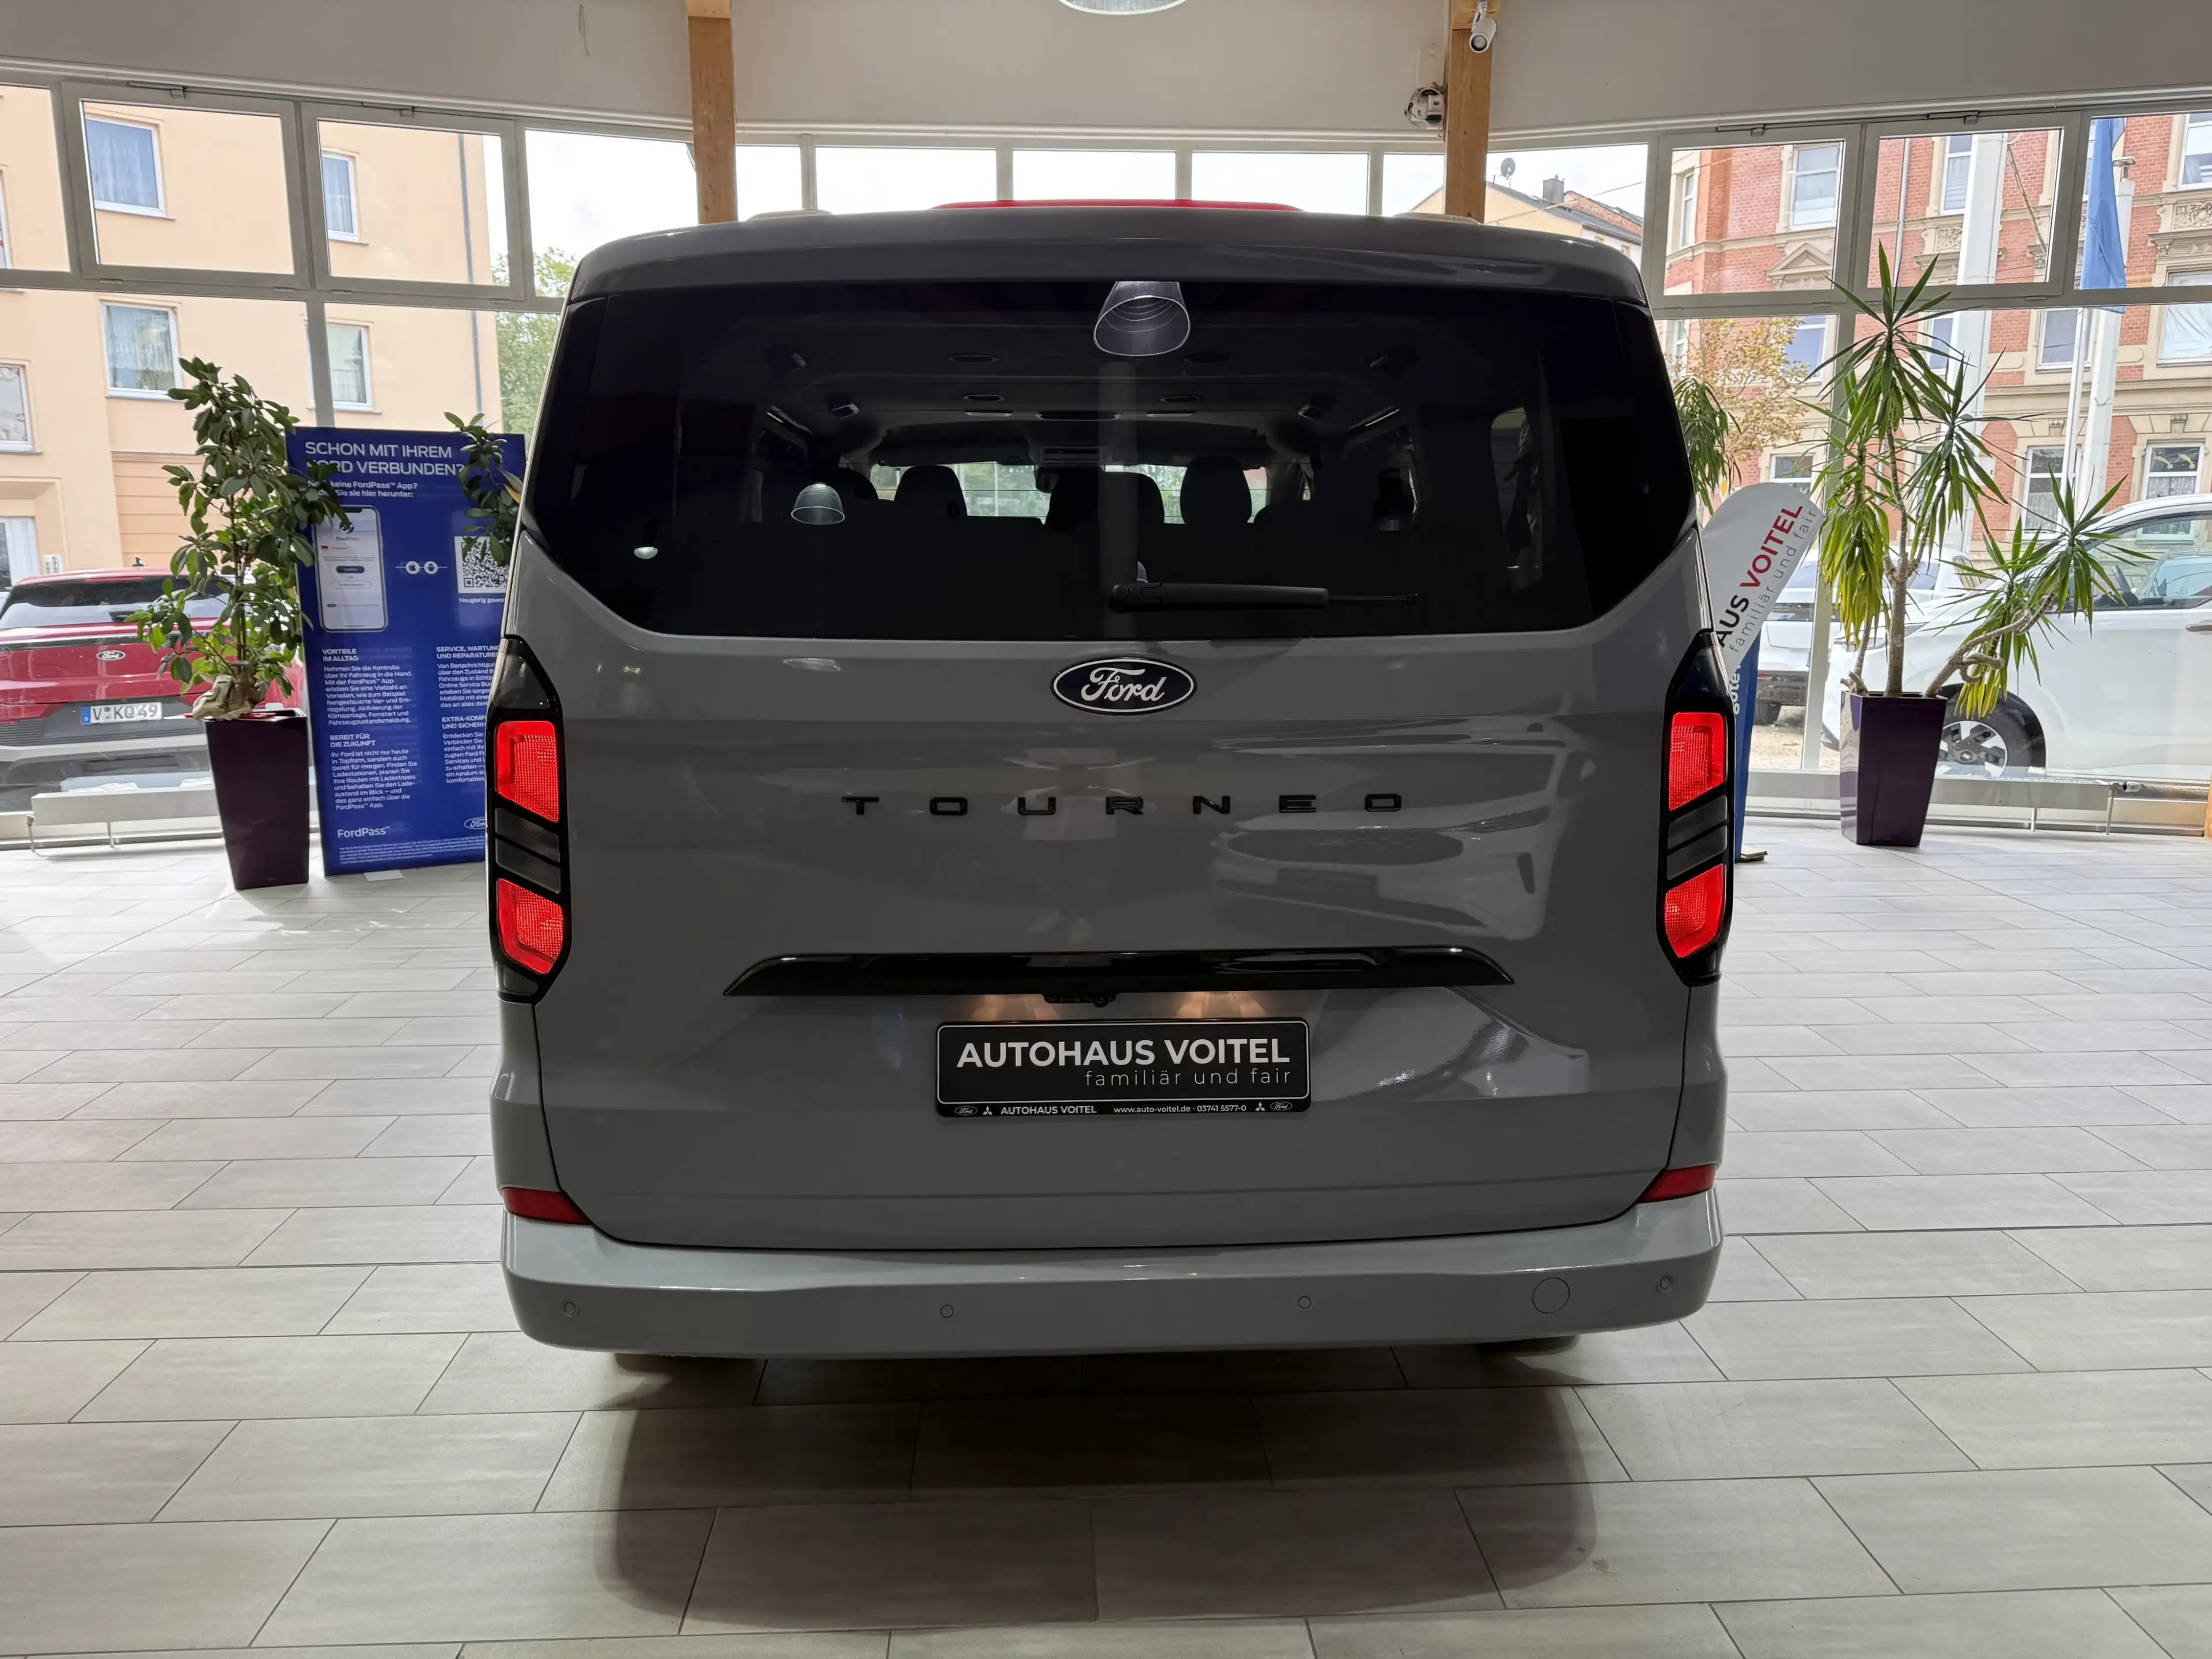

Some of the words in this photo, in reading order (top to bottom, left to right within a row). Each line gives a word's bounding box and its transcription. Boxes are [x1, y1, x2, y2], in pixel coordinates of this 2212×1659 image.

[305, 442, 365, 456] SCHON
[370, 444, 398, 457] MIT
[403, 445, 452, 459] IHREM
[356, 461, 464, 476] VERBUNDEN?
[1740, 506, 1803, 588] VOITEL
[1730, 585, 1775, 652] familiär
[1774, 546, 1797, 579] und
[1793, 509, 1817, 539] fair
[101, 652, 120, 660] Ford
[1080, 666, 1165, 704] Ford
[93, 708, 102, 720] V
[840, 793, 1402, 816] TOURNEO
[956, 1039, 1156, 1068] AUTOHAUS
[1164, 1038, 1290, 1065] VOITEL
[1085, 1069, 1181, 1087] familiär
[1194, 1068, 1238, 1085] und
[1251, 1067, 1290, 1084] fair
[1001, 1106, 1058, 1115] AUTOHAUS
[1060, 1105, 1097, 1114] VOITEL
[1113, 1105, 1191, 1113] www.auto-voitel.de
